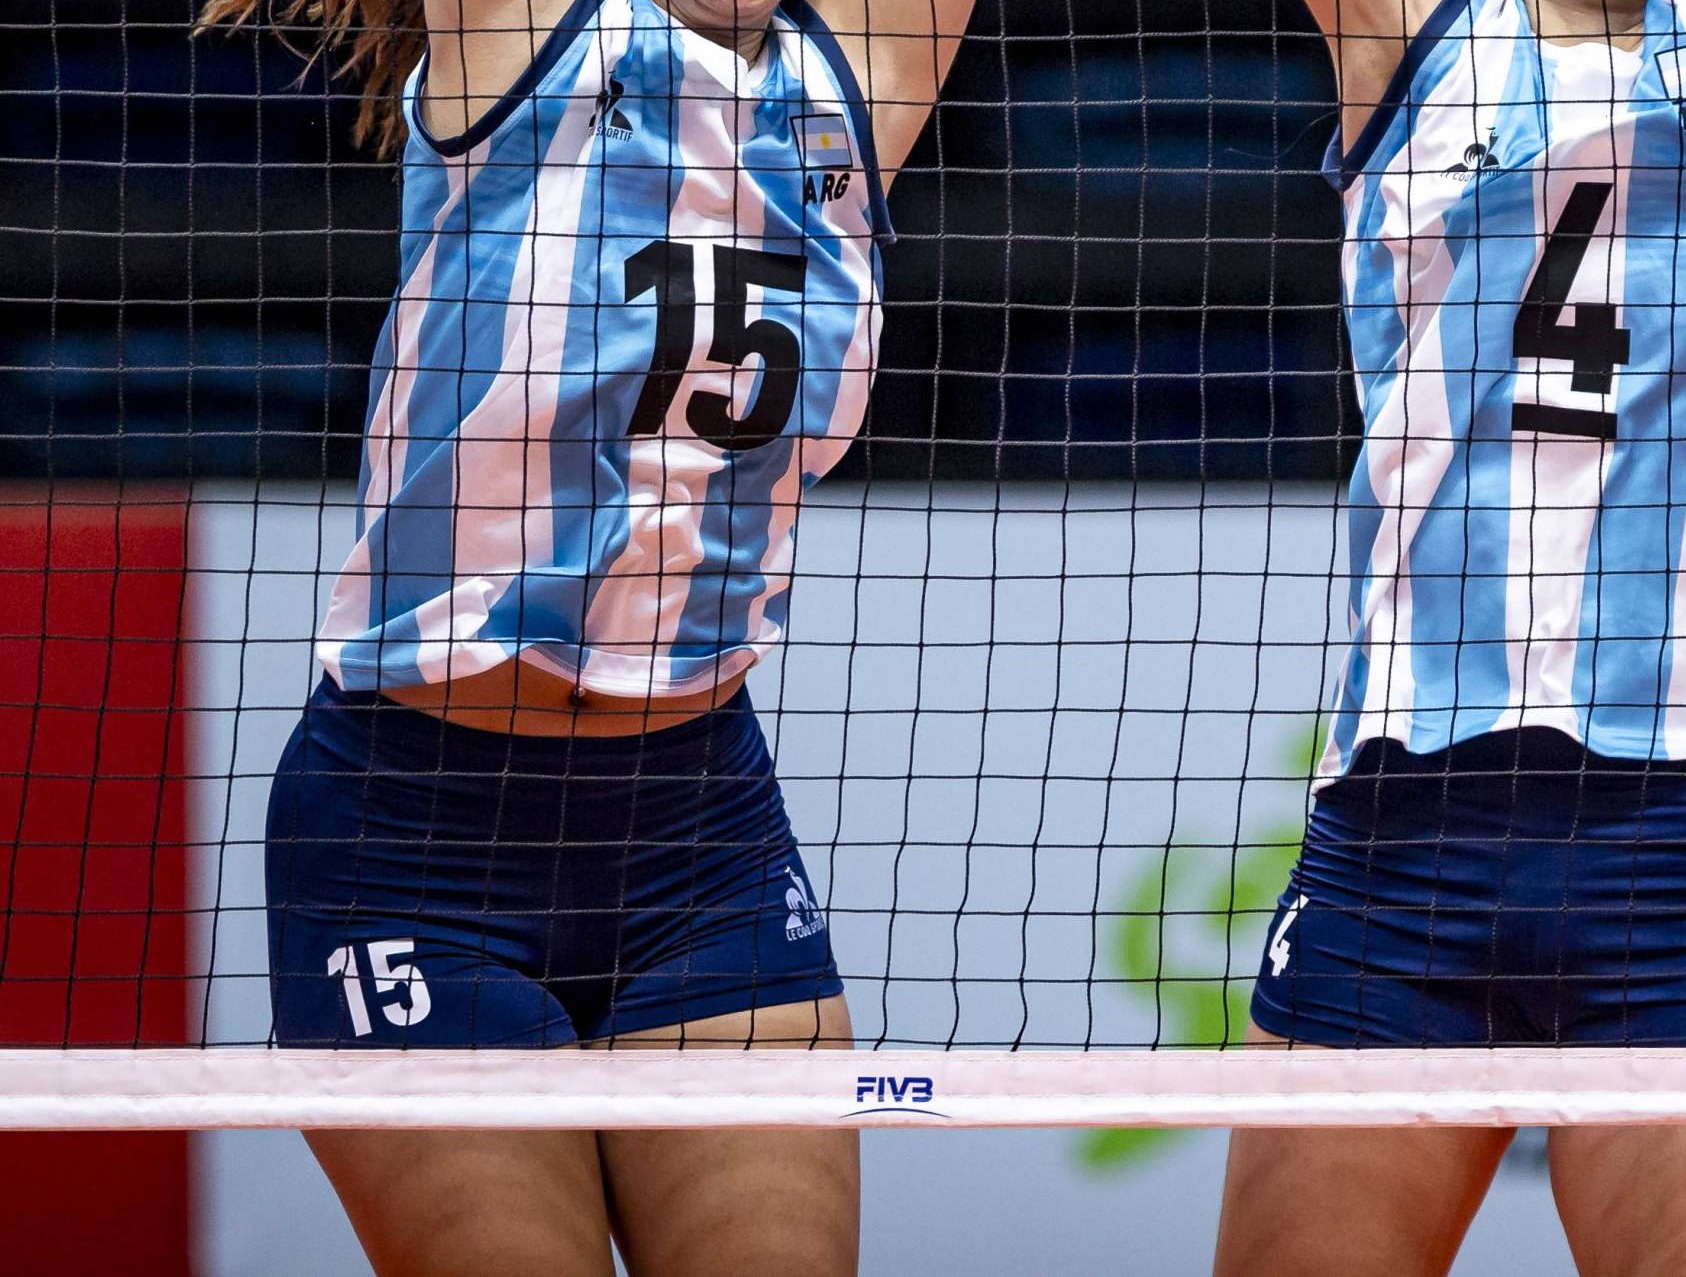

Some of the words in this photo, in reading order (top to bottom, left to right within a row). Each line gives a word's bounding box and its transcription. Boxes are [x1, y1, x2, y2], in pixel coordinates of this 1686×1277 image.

[803, 172, 851, 204] ARG
[1511, 180, 1631, 396] 4
[623, 238, 808, 451] 15
[1268, 893, 1310, 977] 4
[327, 937, 432, 1038] 15
[856, 1076, 934, 1103] FIVB
